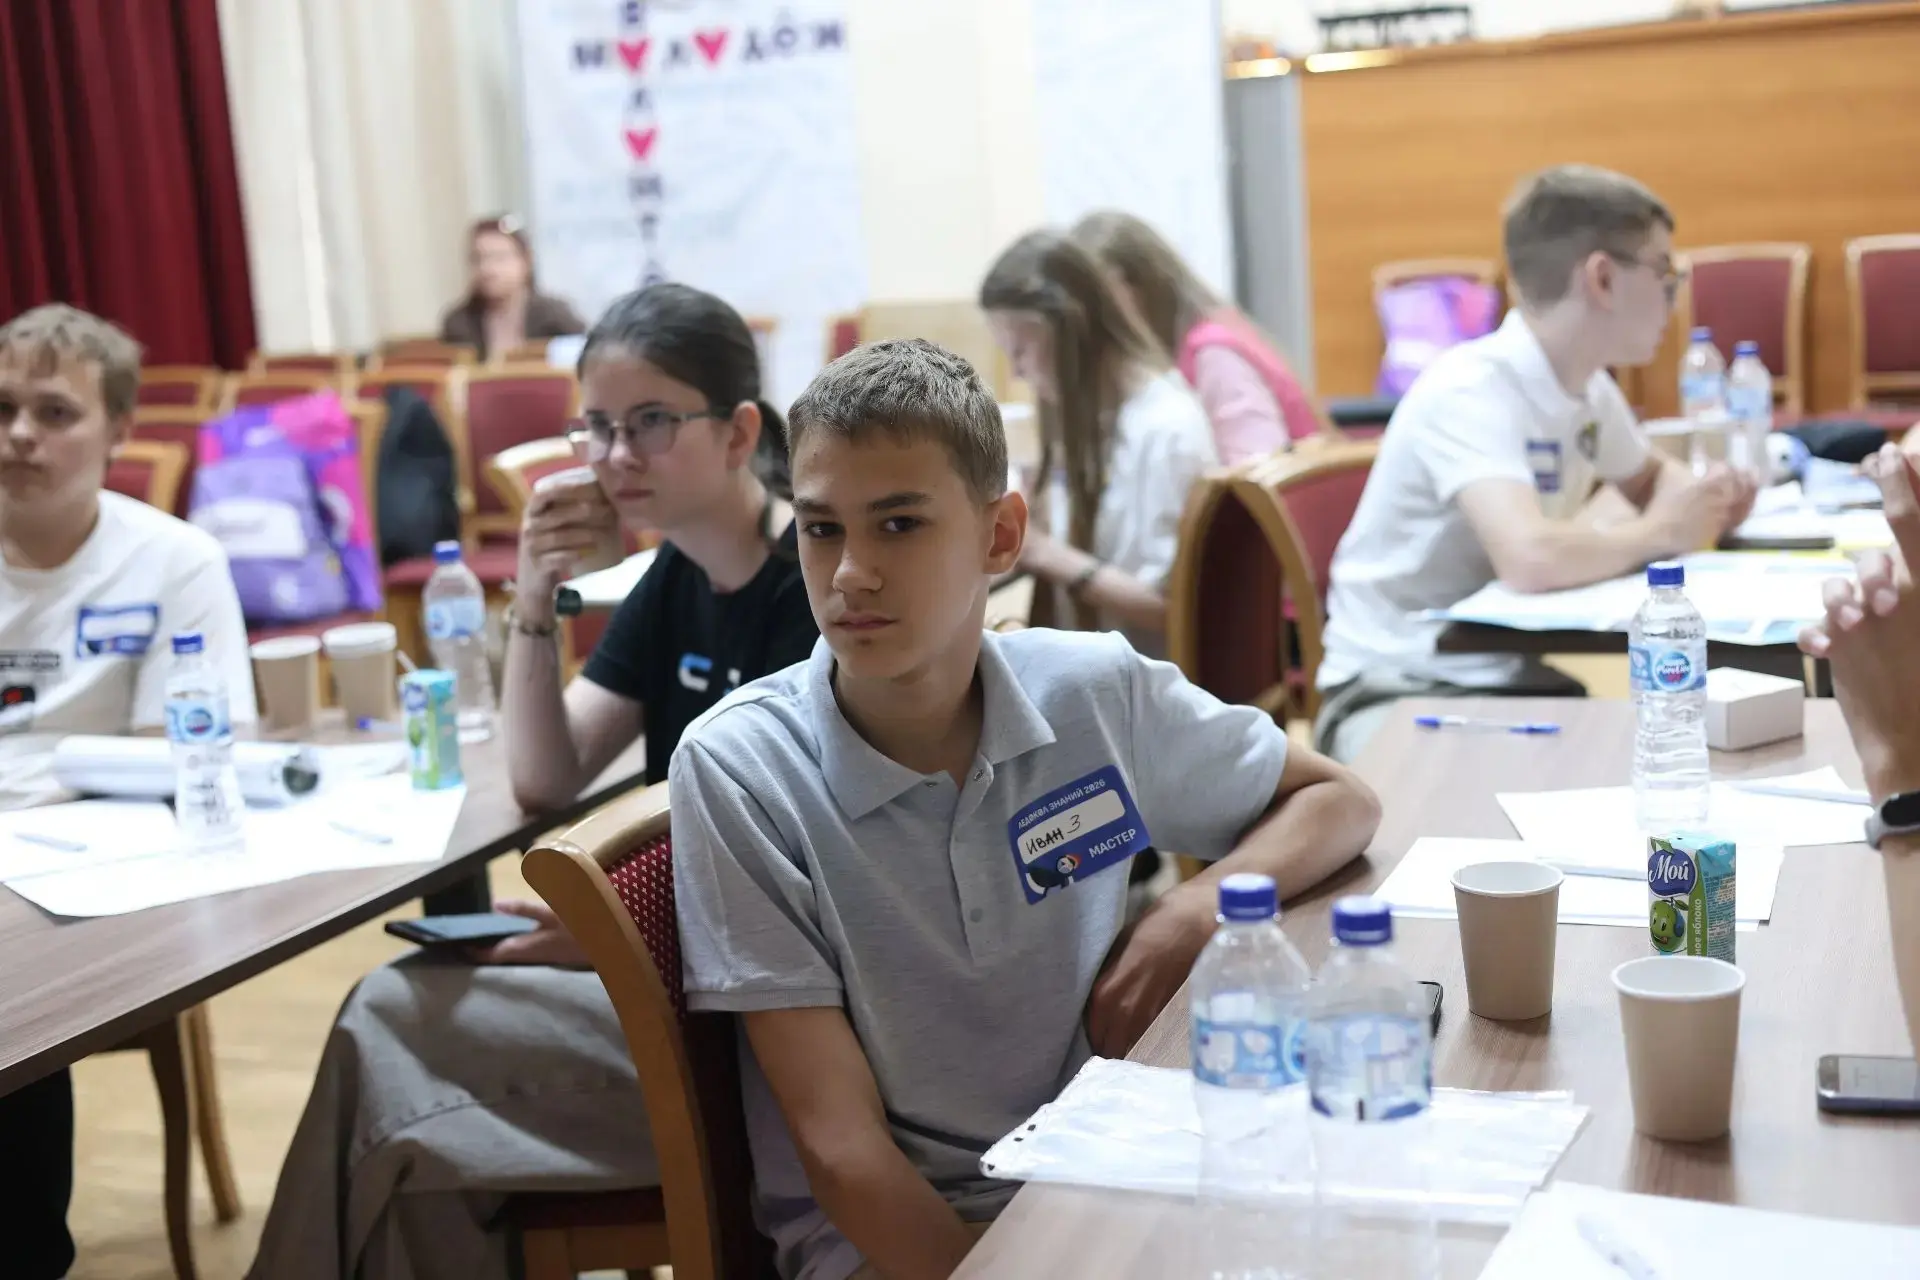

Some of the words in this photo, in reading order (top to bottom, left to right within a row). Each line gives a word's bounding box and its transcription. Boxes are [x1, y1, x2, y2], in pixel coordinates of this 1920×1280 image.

[1050, 787, 1084, 810] ЗНАНИЙ
[1084, 779, 1106, 794] 2026
[1025, 828, 1064, 855] ИВАН
[1088, 828, 1137, 858] МАСТЕР
[1649, 855, 1689, 884] Мой
[1693, 898, 1702, 935] яблоко
